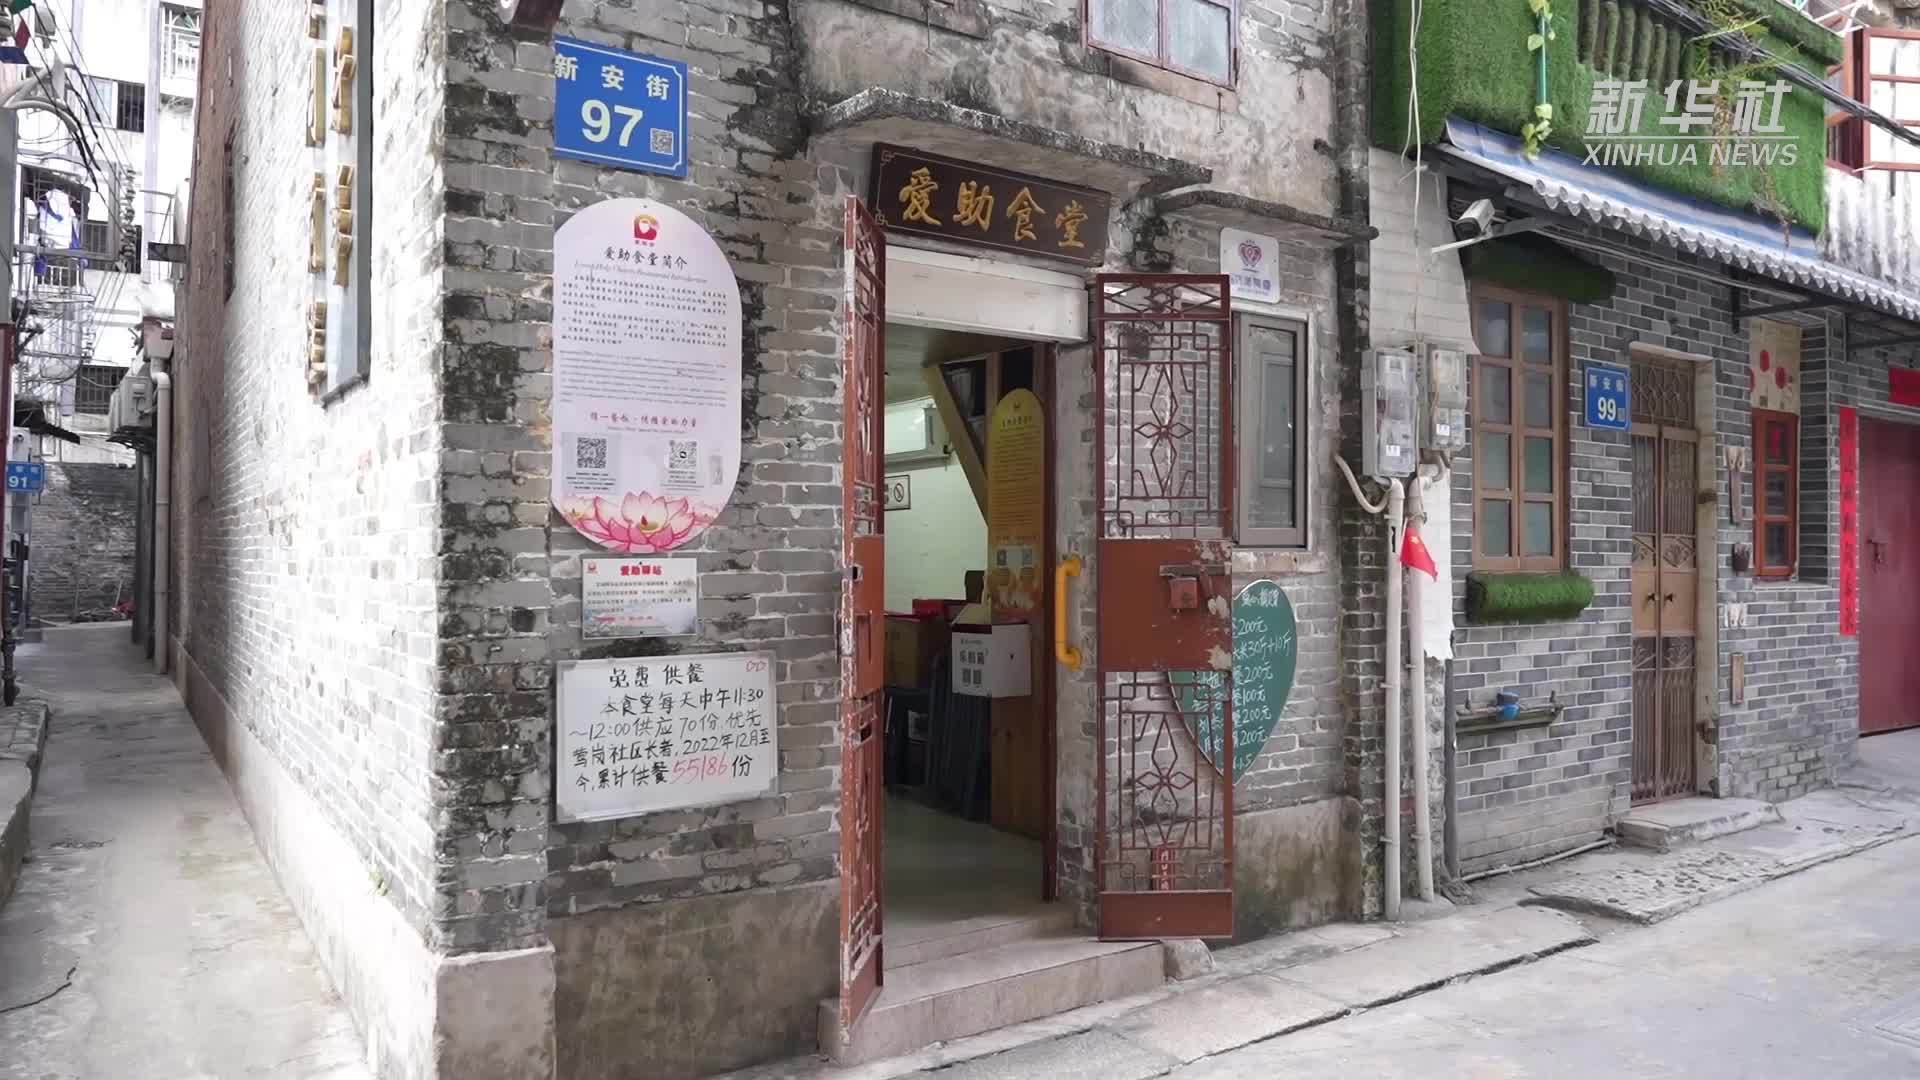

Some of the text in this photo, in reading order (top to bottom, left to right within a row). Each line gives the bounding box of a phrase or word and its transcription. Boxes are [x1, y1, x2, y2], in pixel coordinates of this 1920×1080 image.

[554, 53, 669, 101] 新安街
[581, 99, 643, 147] 97
[898, 166, 1089, 248] 爱助食堂
[603, 245, 688, 270] 爱助食堂简介
[1597, 396, 1617, 421] 99
[8, 475, 28, 488] 91
[609, 663, 705, 688] 免费 供餐
